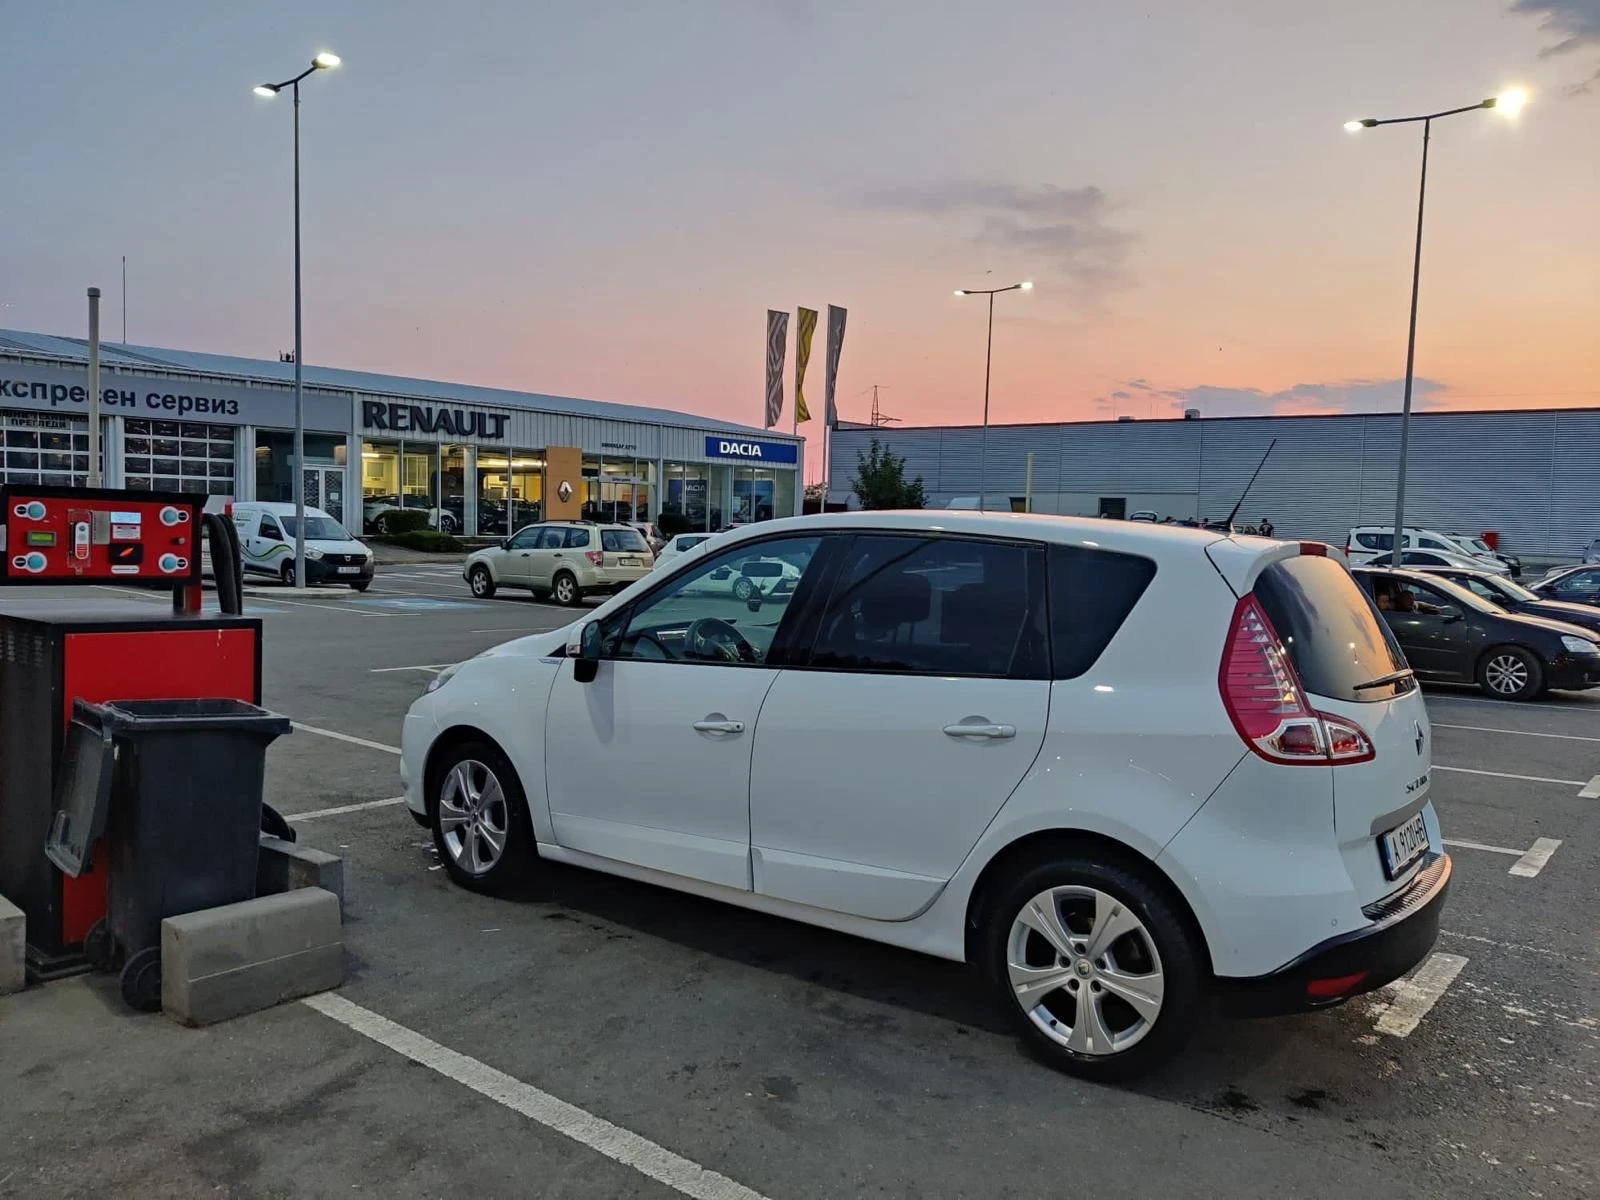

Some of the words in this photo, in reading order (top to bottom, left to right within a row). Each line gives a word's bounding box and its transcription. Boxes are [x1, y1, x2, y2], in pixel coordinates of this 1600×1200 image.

[145, 391, 239, 416] сервиз
[362, 400, 511, 440] RENAULT
[719, 441, 762, 458] DACIA
